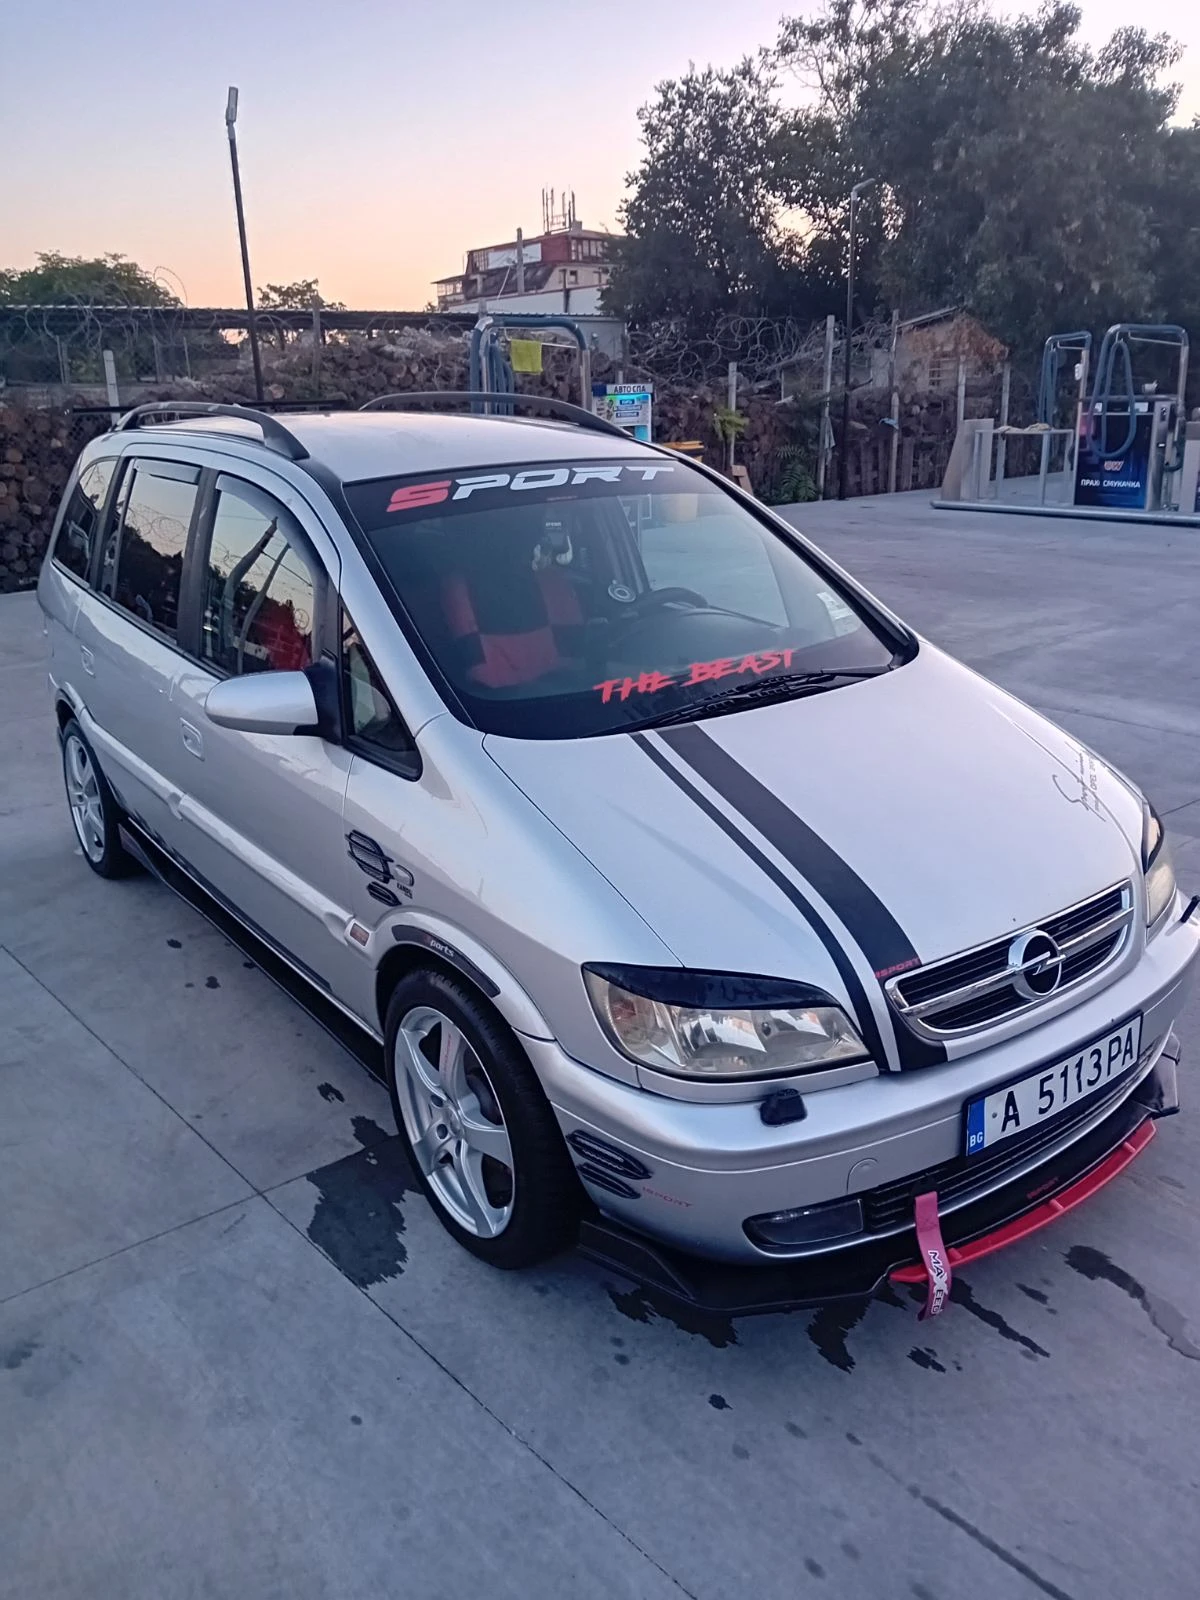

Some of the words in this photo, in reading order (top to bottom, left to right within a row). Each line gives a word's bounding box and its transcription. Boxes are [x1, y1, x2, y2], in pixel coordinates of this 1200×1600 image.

[386, 466, 674, 512] SPORT
[593, 671, 678, 704] THE
[680, 649, 797, 687] BEAST
[970, 1131, 983, 1147] BG
[1001, 1090, 1021, 1132] A
